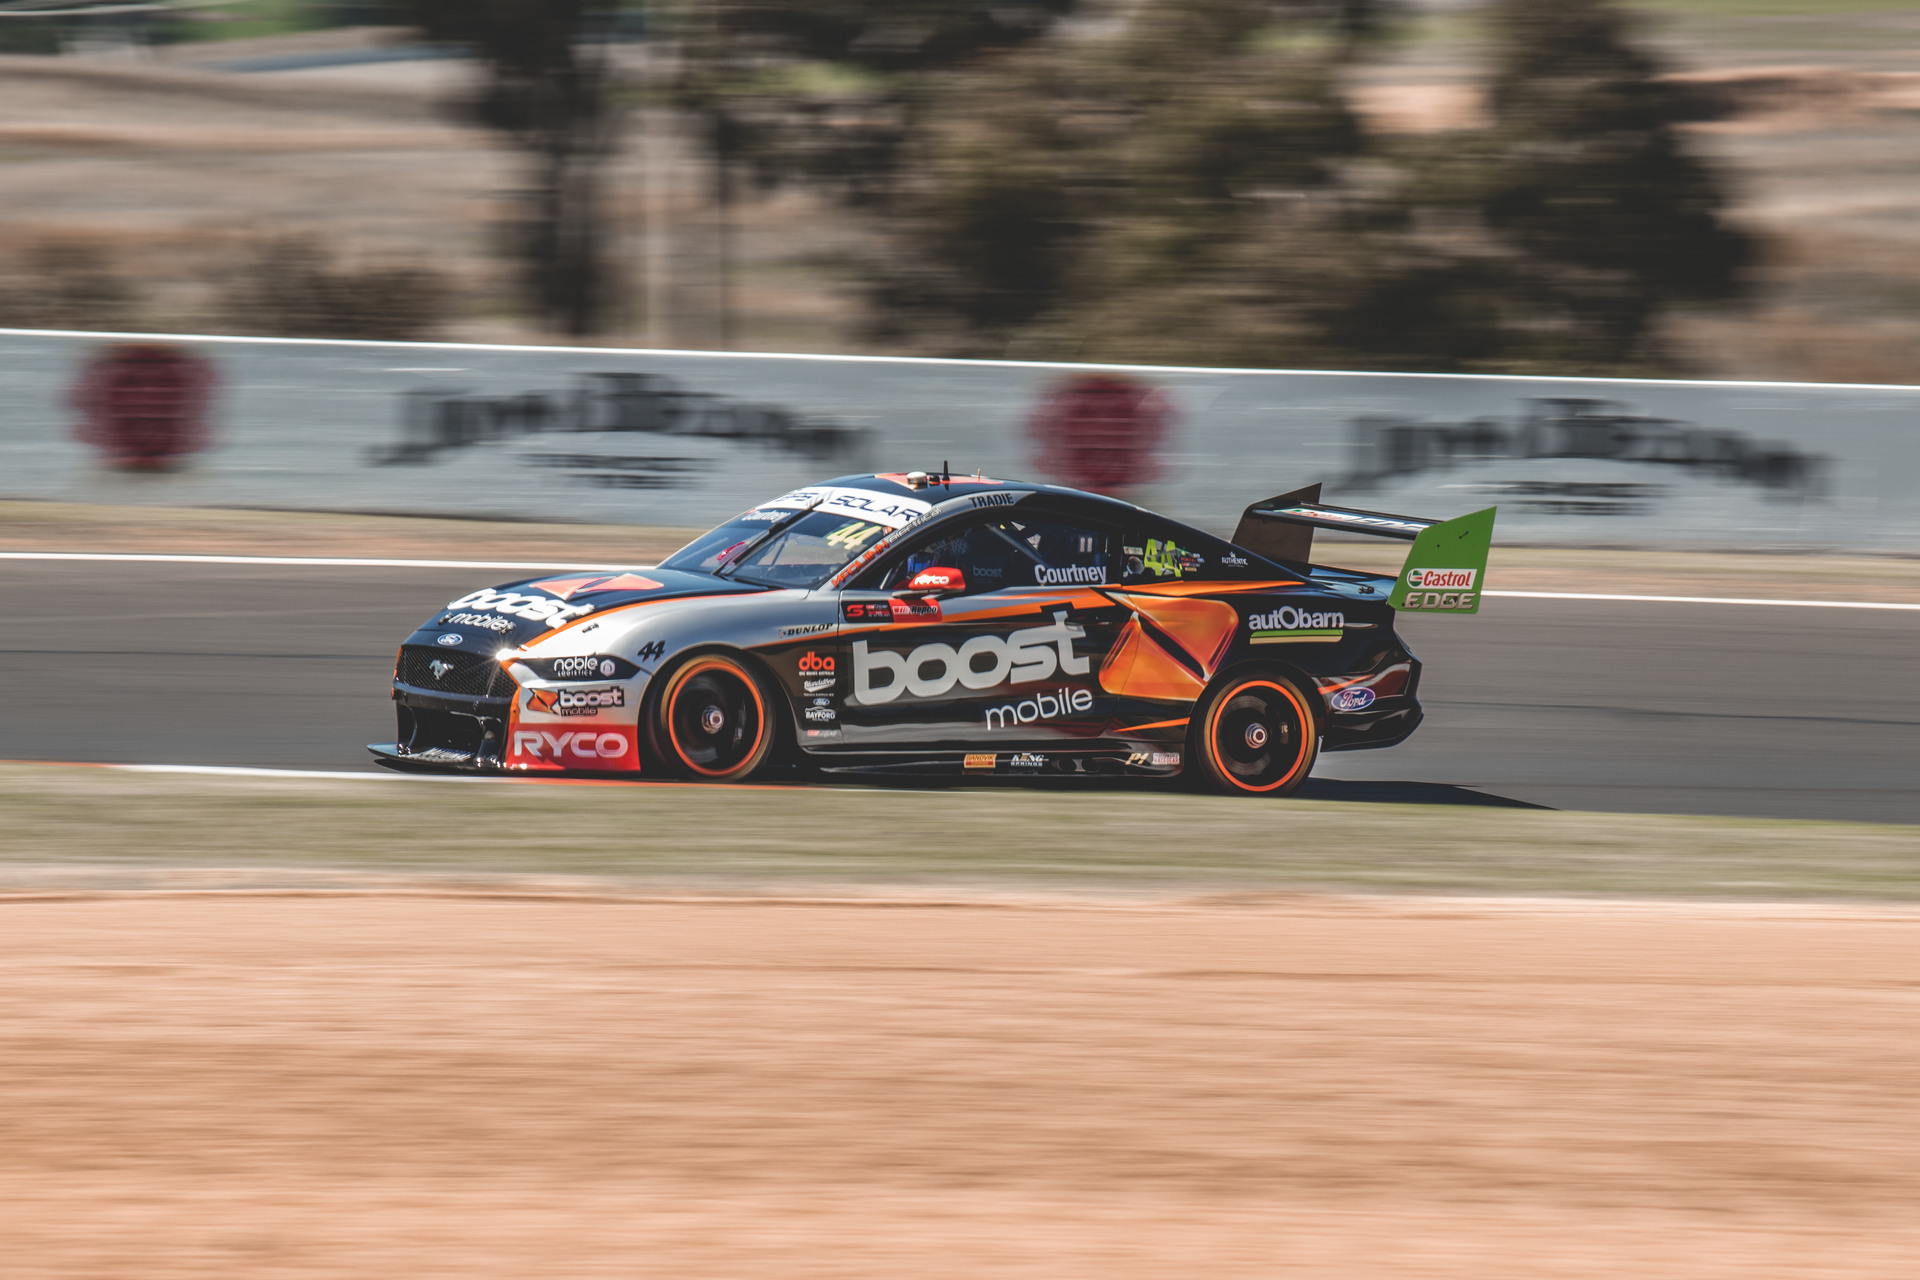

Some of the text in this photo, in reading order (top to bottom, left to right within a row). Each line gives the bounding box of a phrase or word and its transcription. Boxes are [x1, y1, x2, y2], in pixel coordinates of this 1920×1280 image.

[829, 495, 922, 522] SOLAR
[969, 493, 1014, 508] TRADIE
[826, 521, 882, 550] 44
[973, 565, 1003, 578] boost
[1034, 563, 1107, 585] Courtney
[1423, 570, 1470, 587] Castrol
[447, 588, 595, 630] boost
[1403, 591, 1477, 609] EDGE
[448, 612, 509, 631] mobile
[787, 622, 833, 636] DUNLOP
[637, 640, 666, 662] 44
[852, 610, 1090, 706] boost
[553, 655, 598, 672] noble
[798, 651, 835, 671] dba
[559, 685, 623, 707] boost
[1339, 690, 1368, 709] Ford
[560, 706, 597, 716] mobile
[805, 711, 836, 720] BAYFORD
[985, 688, 1093, 731] mobile
[513, 731, 629, 758] RYCO
[1125, 752, 1149, 765] P1
